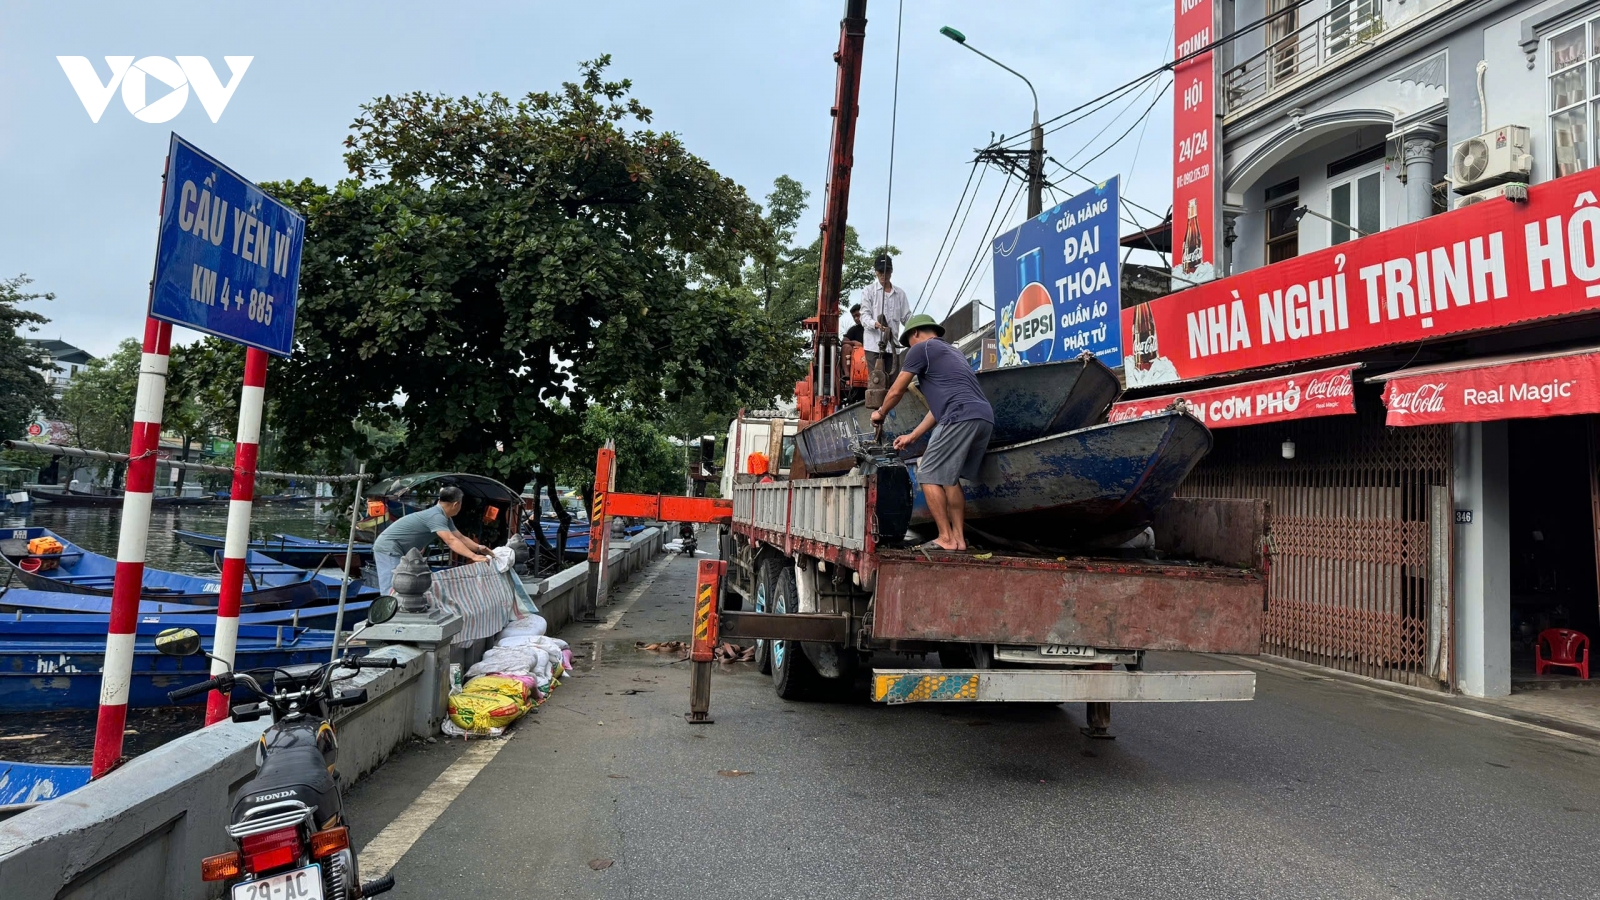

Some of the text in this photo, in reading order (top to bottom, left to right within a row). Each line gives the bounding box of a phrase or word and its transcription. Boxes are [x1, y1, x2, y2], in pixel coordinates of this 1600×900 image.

[1177, 26, 1209, 64] TRỊNH
[1184, 78, 1203, 112] HỘI
[1178, 129, 1208, 163] 24/24
[178, 172, 229, 247] CẦU
[232, 201, 271, 269] YẾN
[1056, 198, 1108, 234] CỬA HÀNG
[1063, 225, 1100, 265] ĐẠI
[190, 263, 217, 309] KM
[220, 277, 231, 312] 4
[247, 288, 274, 327] 885
[1055, 261, 1112, 304] THOA
[1186, 289, 1252, 360] NHÀ
[1258, 253, 1349, 346] NGHỈ
[1360, 231, 1508, 329] TRỊNH
[1014, 312, 1054, 343] PEPSI
[1061, 301, 1108, 329] QUẦN ÁO
[1063, 322, 1107, 353] PHẬT TỬ
[1209, 393, 1252, 422] CƠM
[1256, 380, 1301, 417] PHỞ
[1305, 374, 1352, 400] Coca-Cola
[1388, 382, 1448, 414] oca-Cola
[1464, 385, 1504, 406] Real
[1456, 511, 1471, 523] 346
[255, 789, 298, 803] HONDA
